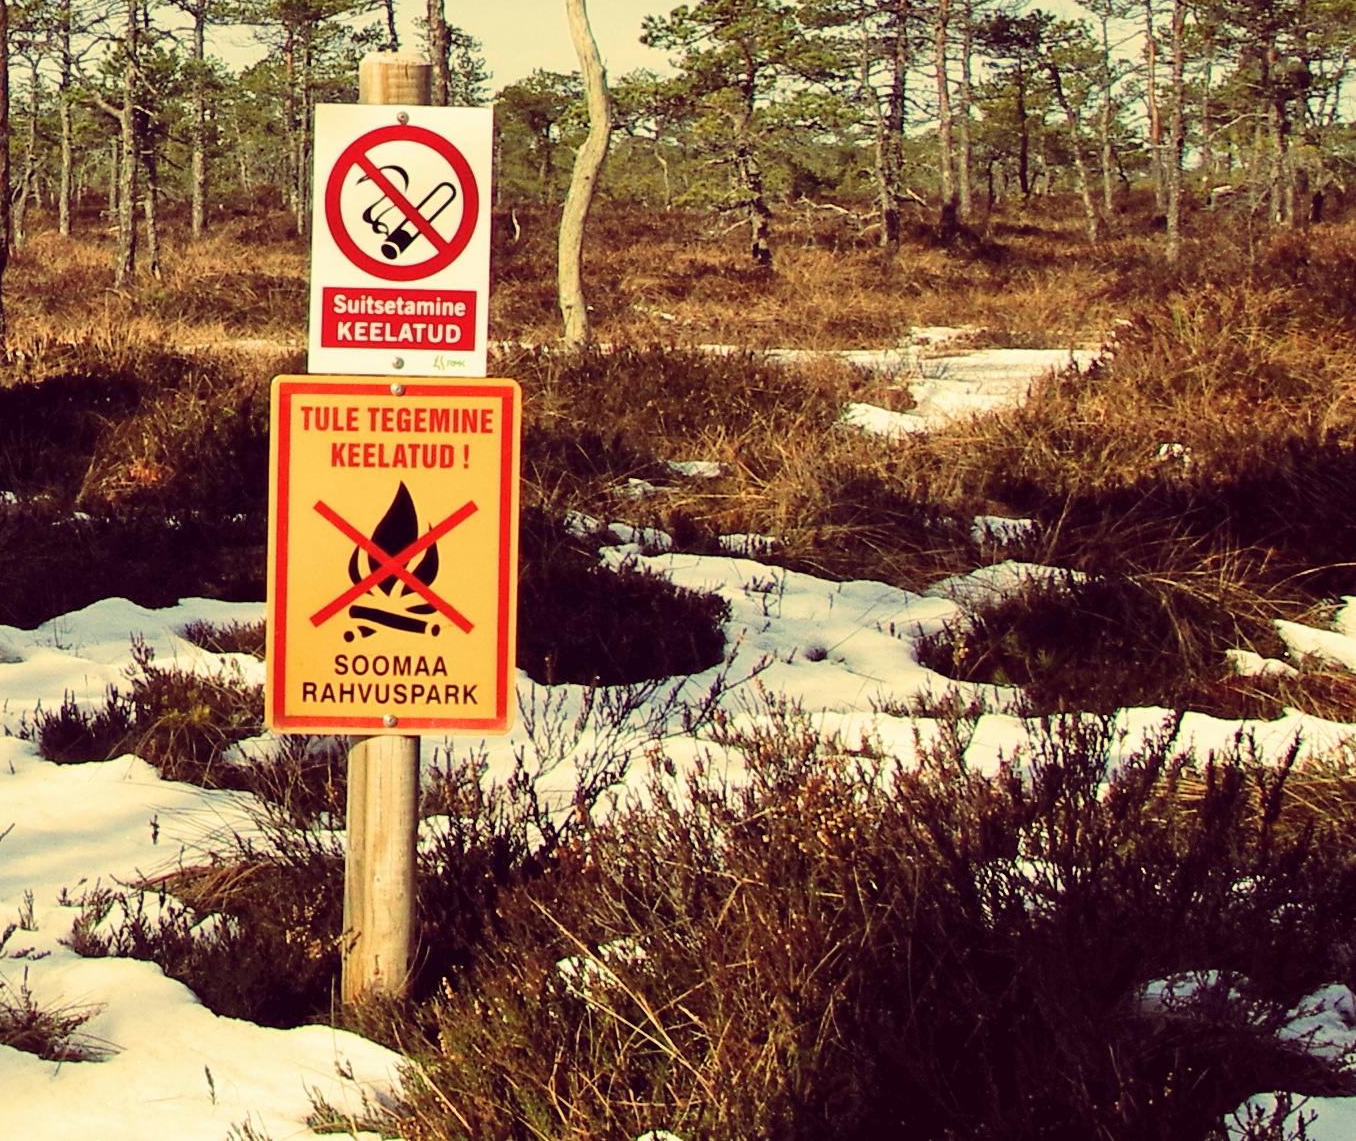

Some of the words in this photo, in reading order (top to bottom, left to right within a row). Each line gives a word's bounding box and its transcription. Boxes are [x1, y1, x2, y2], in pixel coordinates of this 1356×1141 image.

[333, 294, 466, 317] Suitsetamine
[337, 321, 462, 344] KEELATUD
[301, 406, 359, 433] TULE
[367, 407, 494, 434] TEGEMINE
[330, 443, 455, 469] KEELATUD
[334, 654, 448, 677] SOOMAA
[301, 682, 478, 705] RAHVUSPARK
